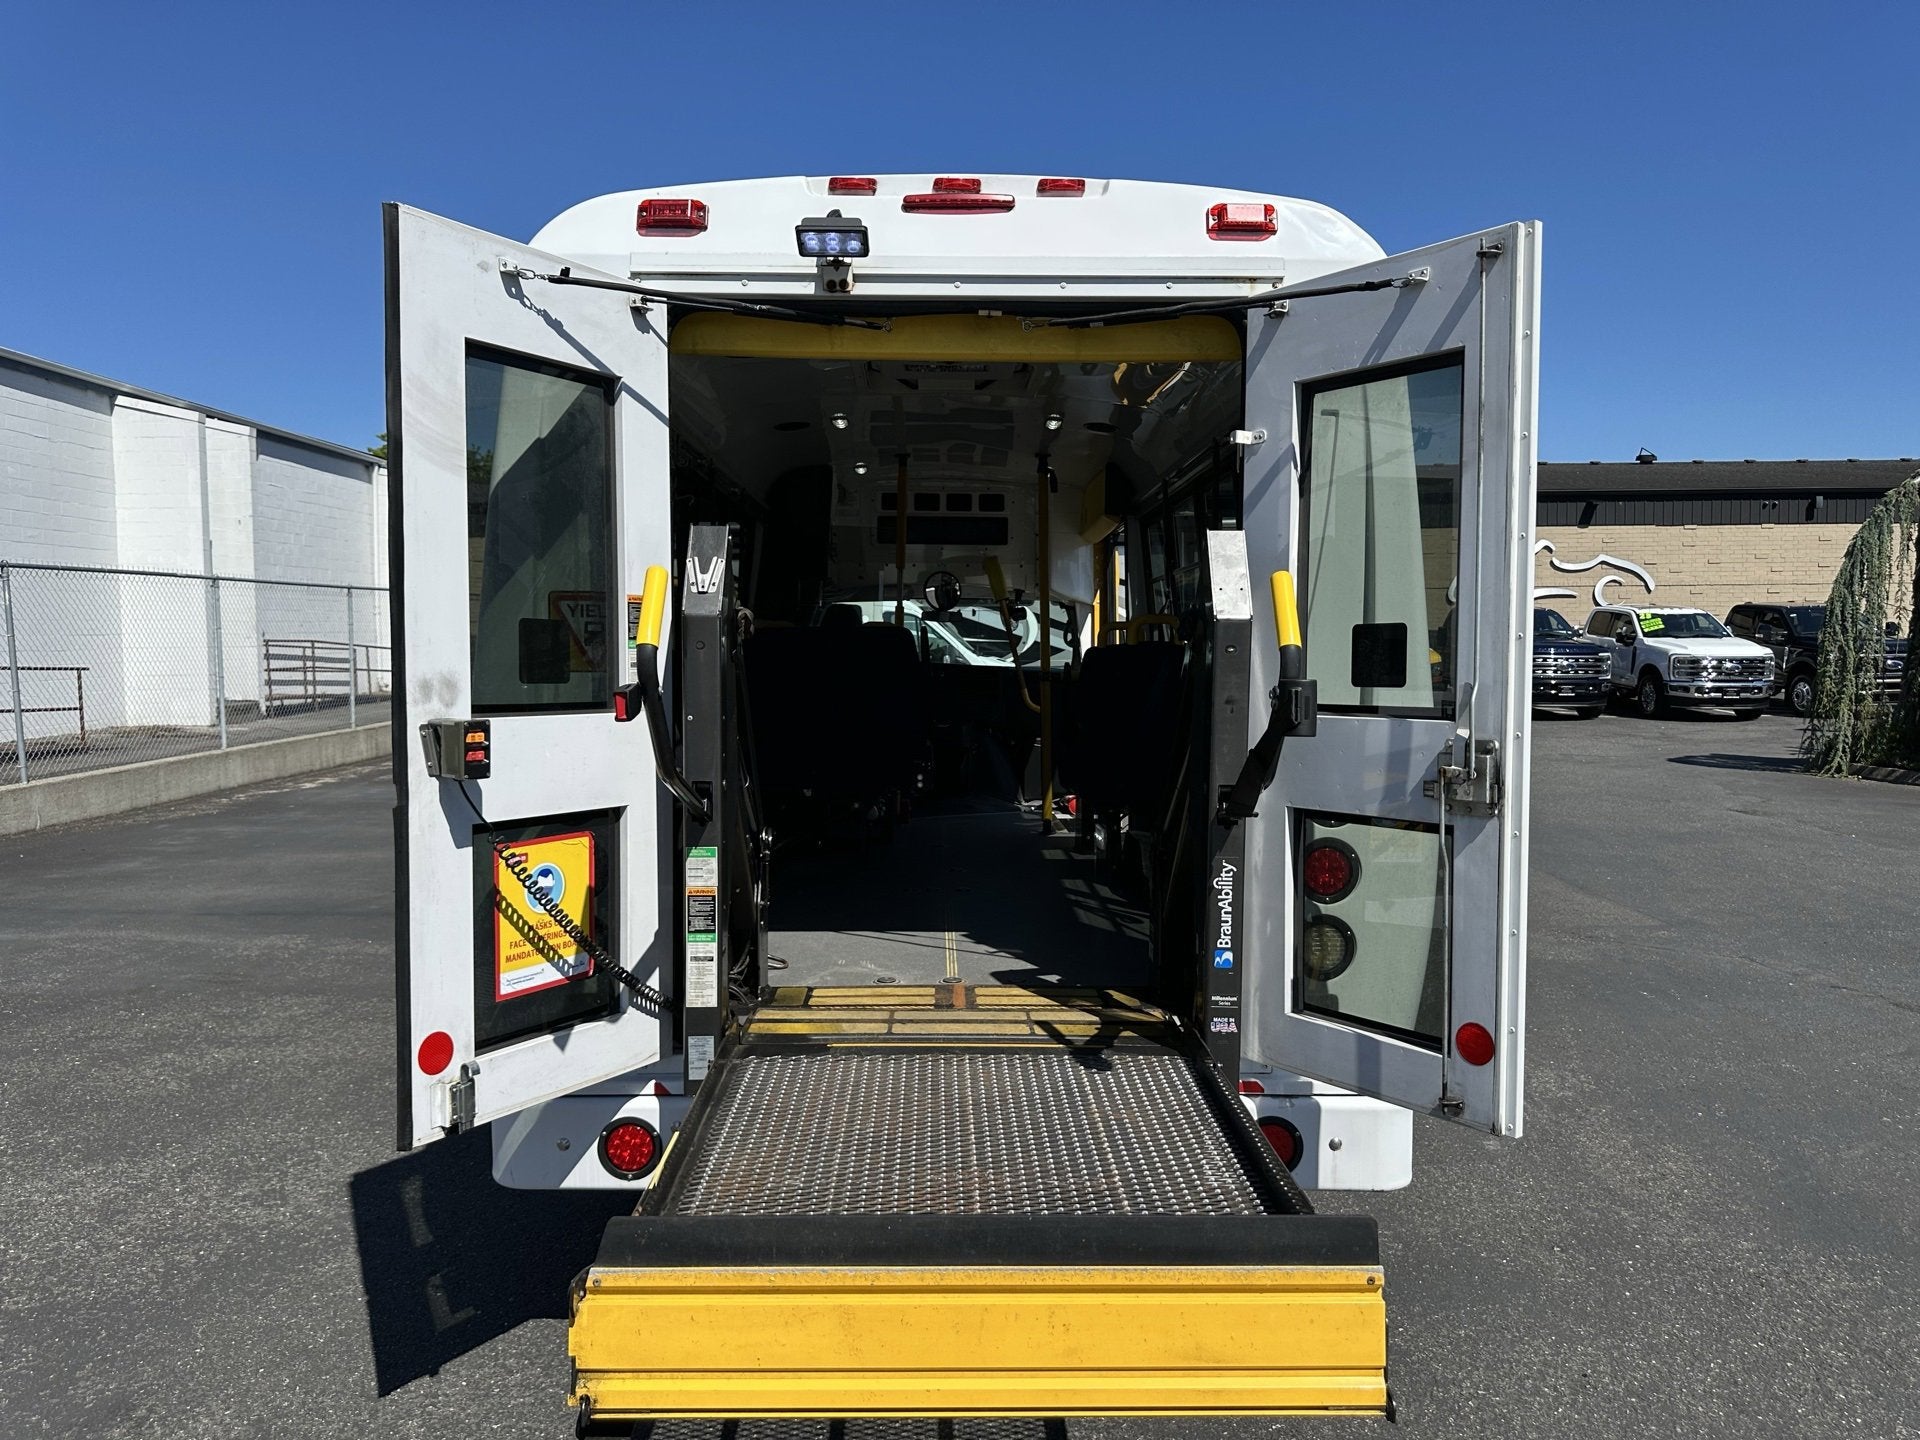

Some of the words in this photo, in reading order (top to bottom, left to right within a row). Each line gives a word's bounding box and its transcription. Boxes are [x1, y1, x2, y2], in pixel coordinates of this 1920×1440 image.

[566, 602, 606, 618] YIEL
[1213, 860, 1238, 948] BraunAbility
[509, 939, 527, 950] FACE
[506, 948, 544, 963] MANDATO
[1210, 1021, 1238, 1033] USA
